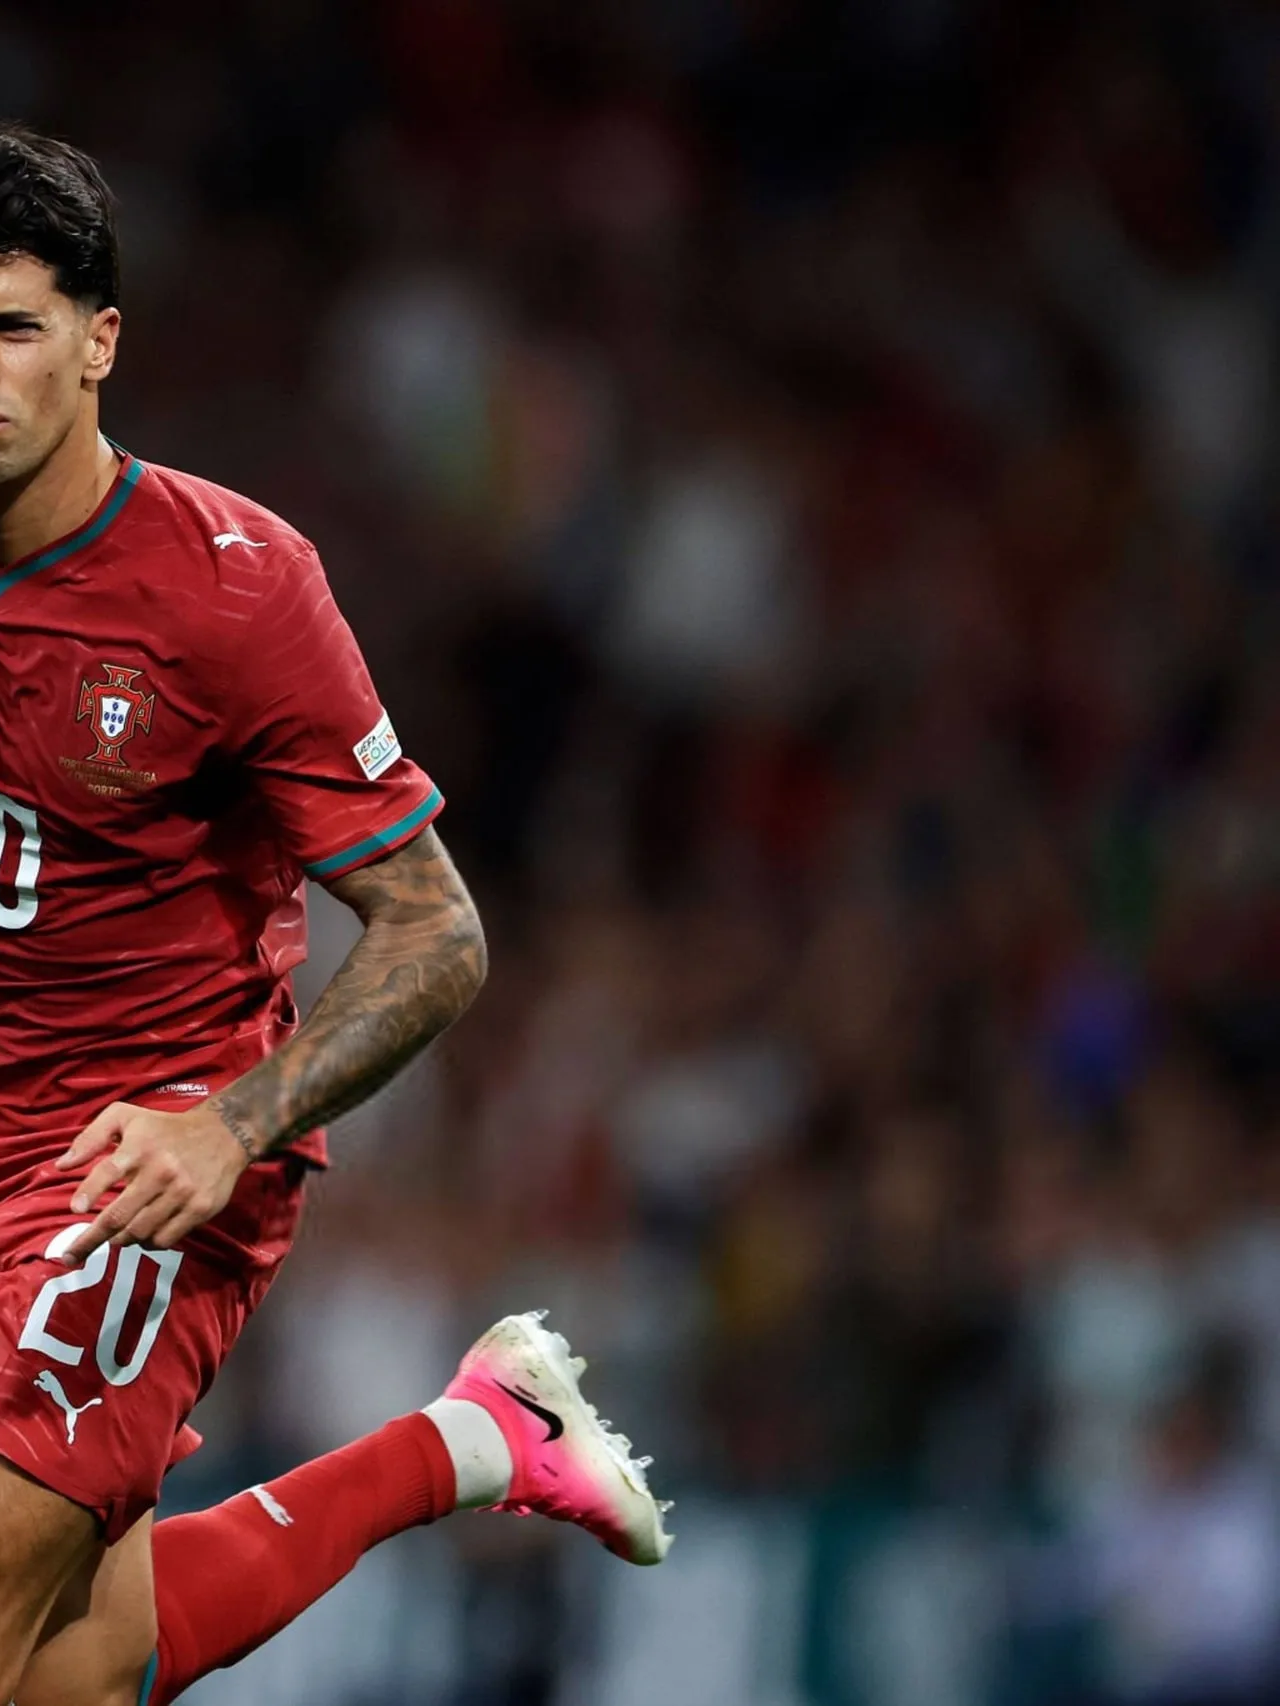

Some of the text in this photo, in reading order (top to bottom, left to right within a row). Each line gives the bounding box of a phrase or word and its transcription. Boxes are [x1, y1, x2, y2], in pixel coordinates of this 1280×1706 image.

[357, 735, 376, 756] UEFA
[87, 784, 122, 797] PORTO
[17, 1222, 184, 1387] 20
